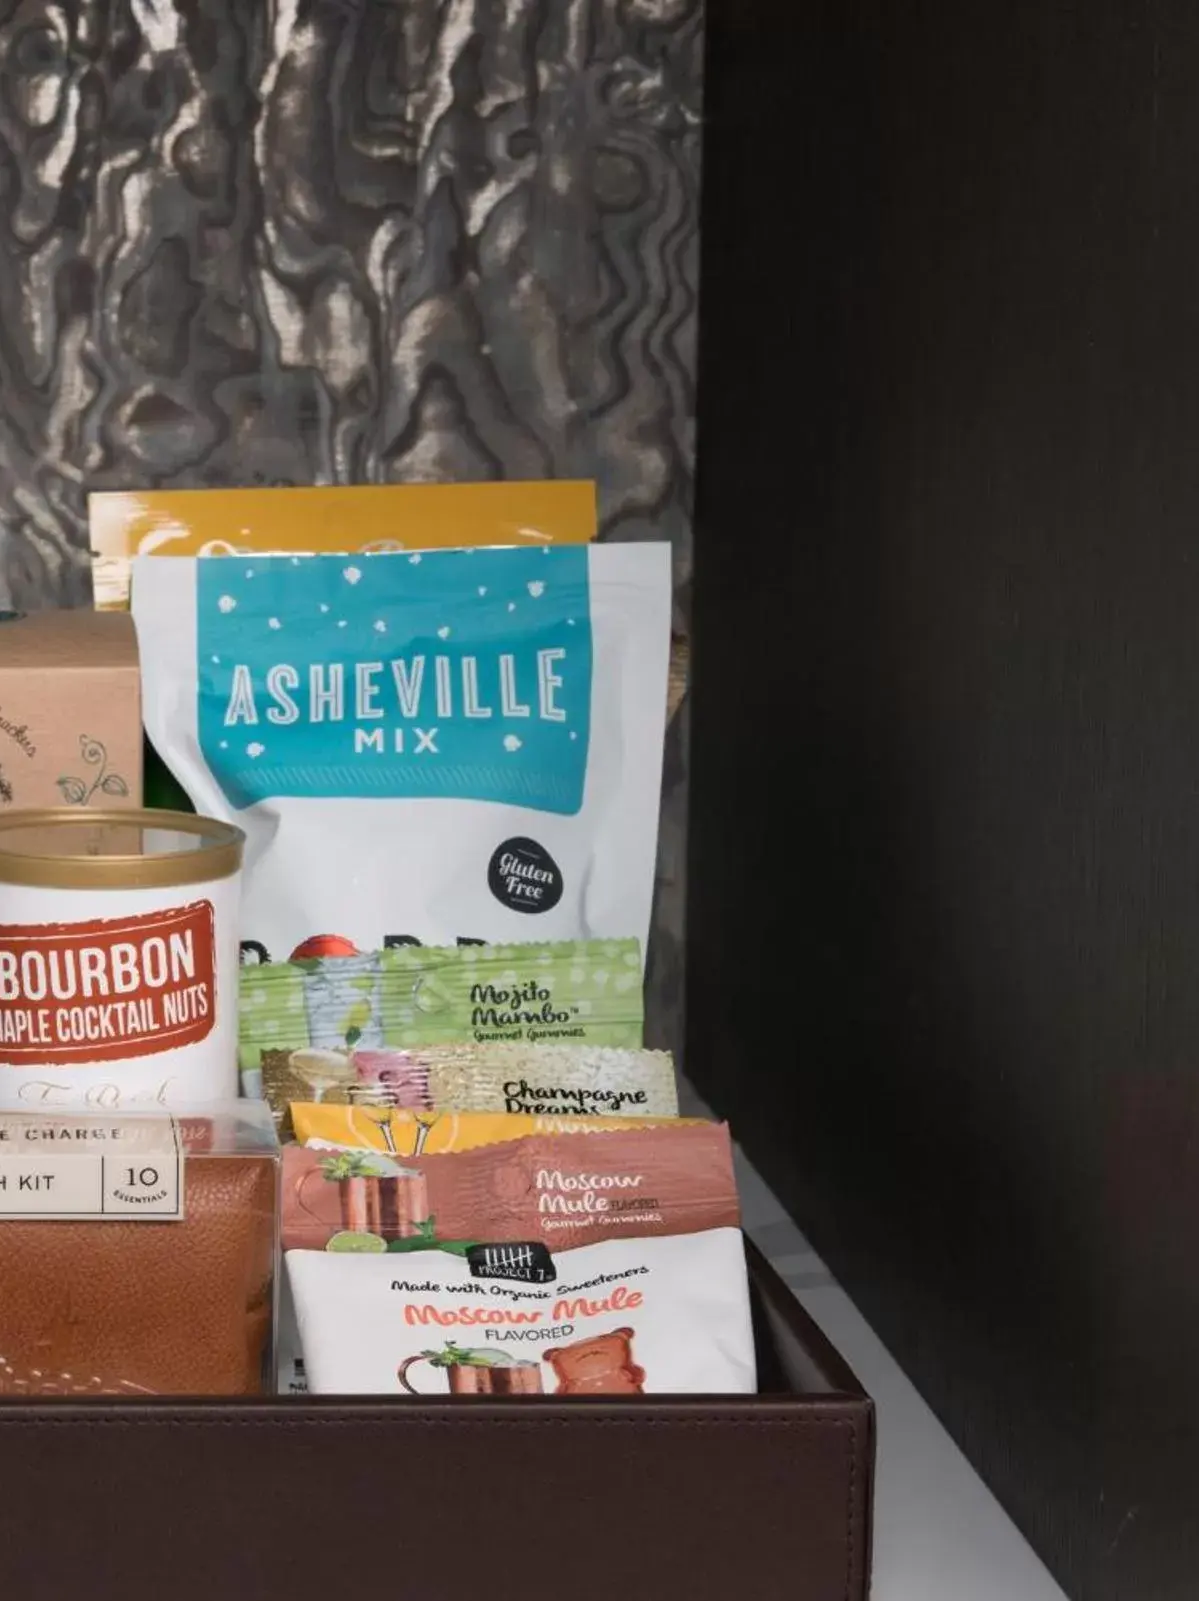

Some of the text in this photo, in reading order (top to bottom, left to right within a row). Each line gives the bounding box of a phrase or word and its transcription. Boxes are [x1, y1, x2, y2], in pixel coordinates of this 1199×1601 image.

[224, 648, 567, 727] ASHEVILLE
[354, 727, 441, 754] MIX
[499, 852, 554, 884] Gluten
[506, 875, 544, 900] Free
[470, 980, 551, 1010] Mojito
[56, 997, 160, 1042] COCKTAIL
[163, 982, 209, 1027] NUTS
[473, 1026, 587, 1043] Gourmet Gummies
[502, 1077, 649, 1111] Champagne
[25, 1128, 122, 1141] CHARGE
[18, 1175, 56, 1191] KIT
[126, 1167, 159, 1187] 10
[536, 1169, 643, 1192] Moscow
[113, 1189, 168, 1204] ESSENTIALS
[538, 1190, 609, 1215] Mule
[390, 1265, 650, 1301] Made with Organic Sweeteners
[478, 1265, 546, 1281] PROJECT 7
[403, 1286, 644, 1327] Moscow Mule
[485, 1324, 575, 1342] FLAVORED
